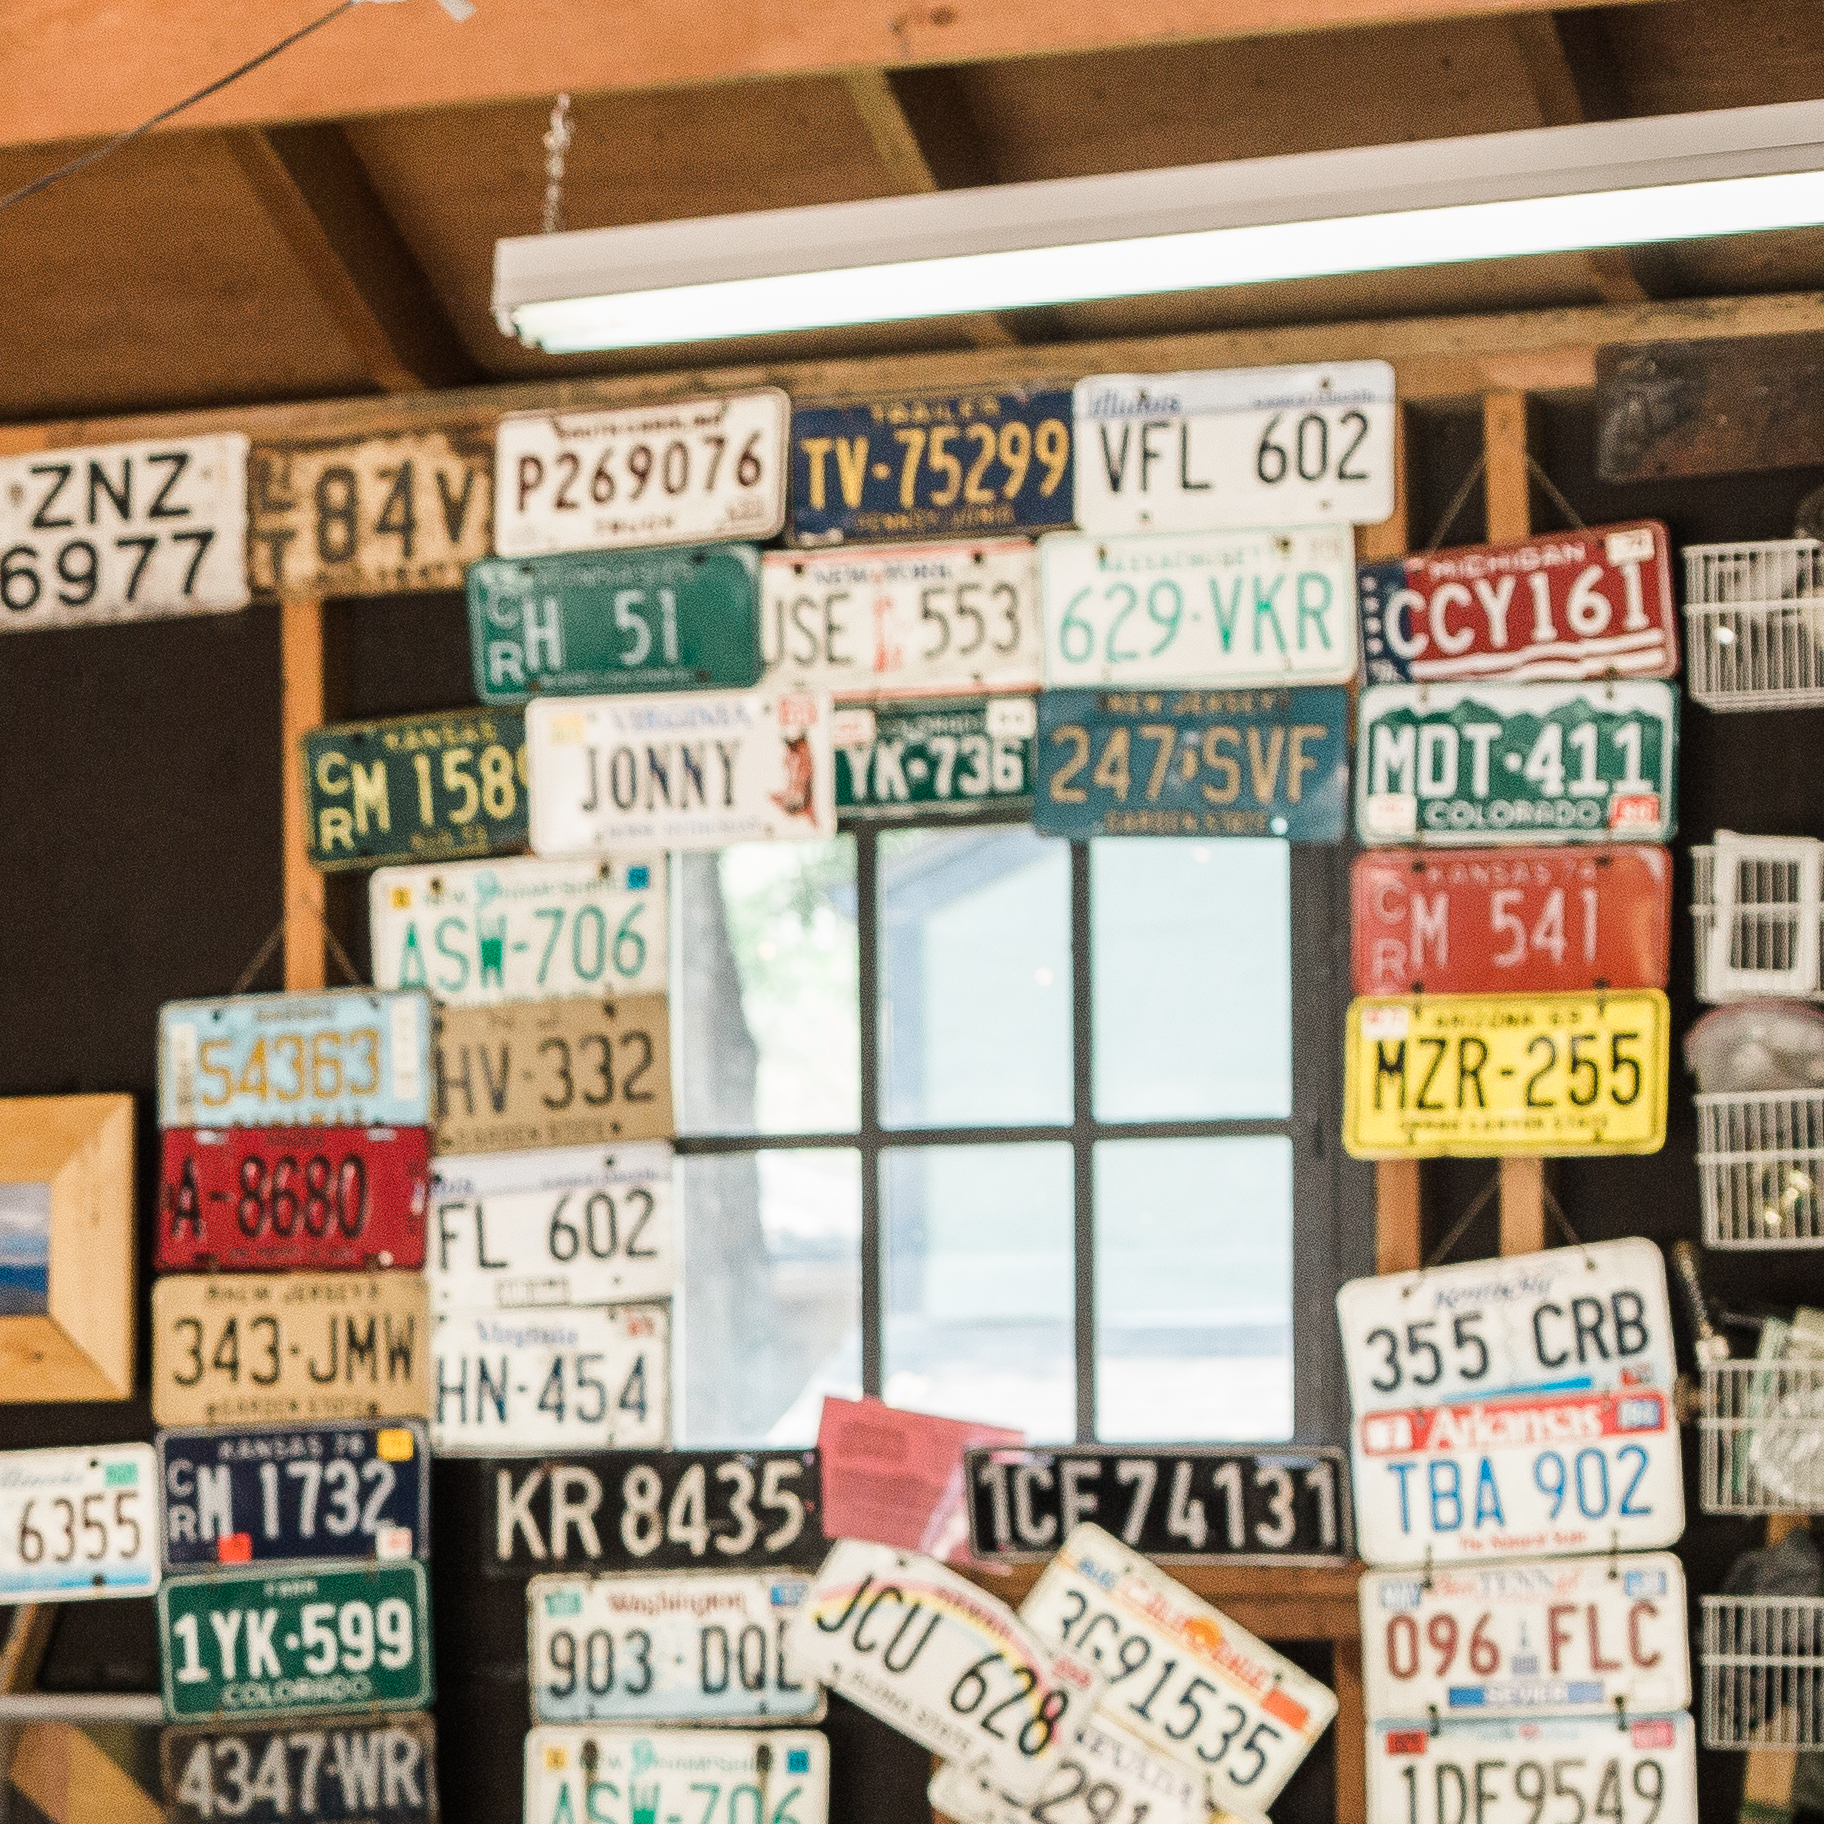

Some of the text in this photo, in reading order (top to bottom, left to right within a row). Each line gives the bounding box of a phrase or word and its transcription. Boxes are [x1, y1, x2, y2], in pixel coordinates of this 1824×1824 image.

[31, 452, 190, 528] ZNZ
[517, 430, 761, 513] P269076
[1101, 411, 1369, 493] VFL 602
[0, 531, 214, 611] 6977
[1385, 563, 1650, 659] CCY161
[920, 582, 1021, 661] 553
[581, 740, 742, 812] JONNY
[1425, 801, 1602, 828] COLORADO
[1489, 888, 1599, 969] 541
[200, 1027, 381, 1107] 54363
[549, 1187, 659, 1263] 602
[1365, 1292, 1649, 1393] 355 CRB
[217, 1435, 324, 1461] KANSAS
[18, 1490, 141, 1565] 6355
[260, 1457, 396, 1541] 1732
[495, 1458, 805, 1562] KR 8435
[1388, 1444, 1653, 1535] TBA 902
[815, 1572, 942, 1674] JCU
[950, 1653, 1068, 1757] 628
[1385, 1600, 1661, 1681] 096 FLC
[222, 1674, 374, 1710] COLORADO
